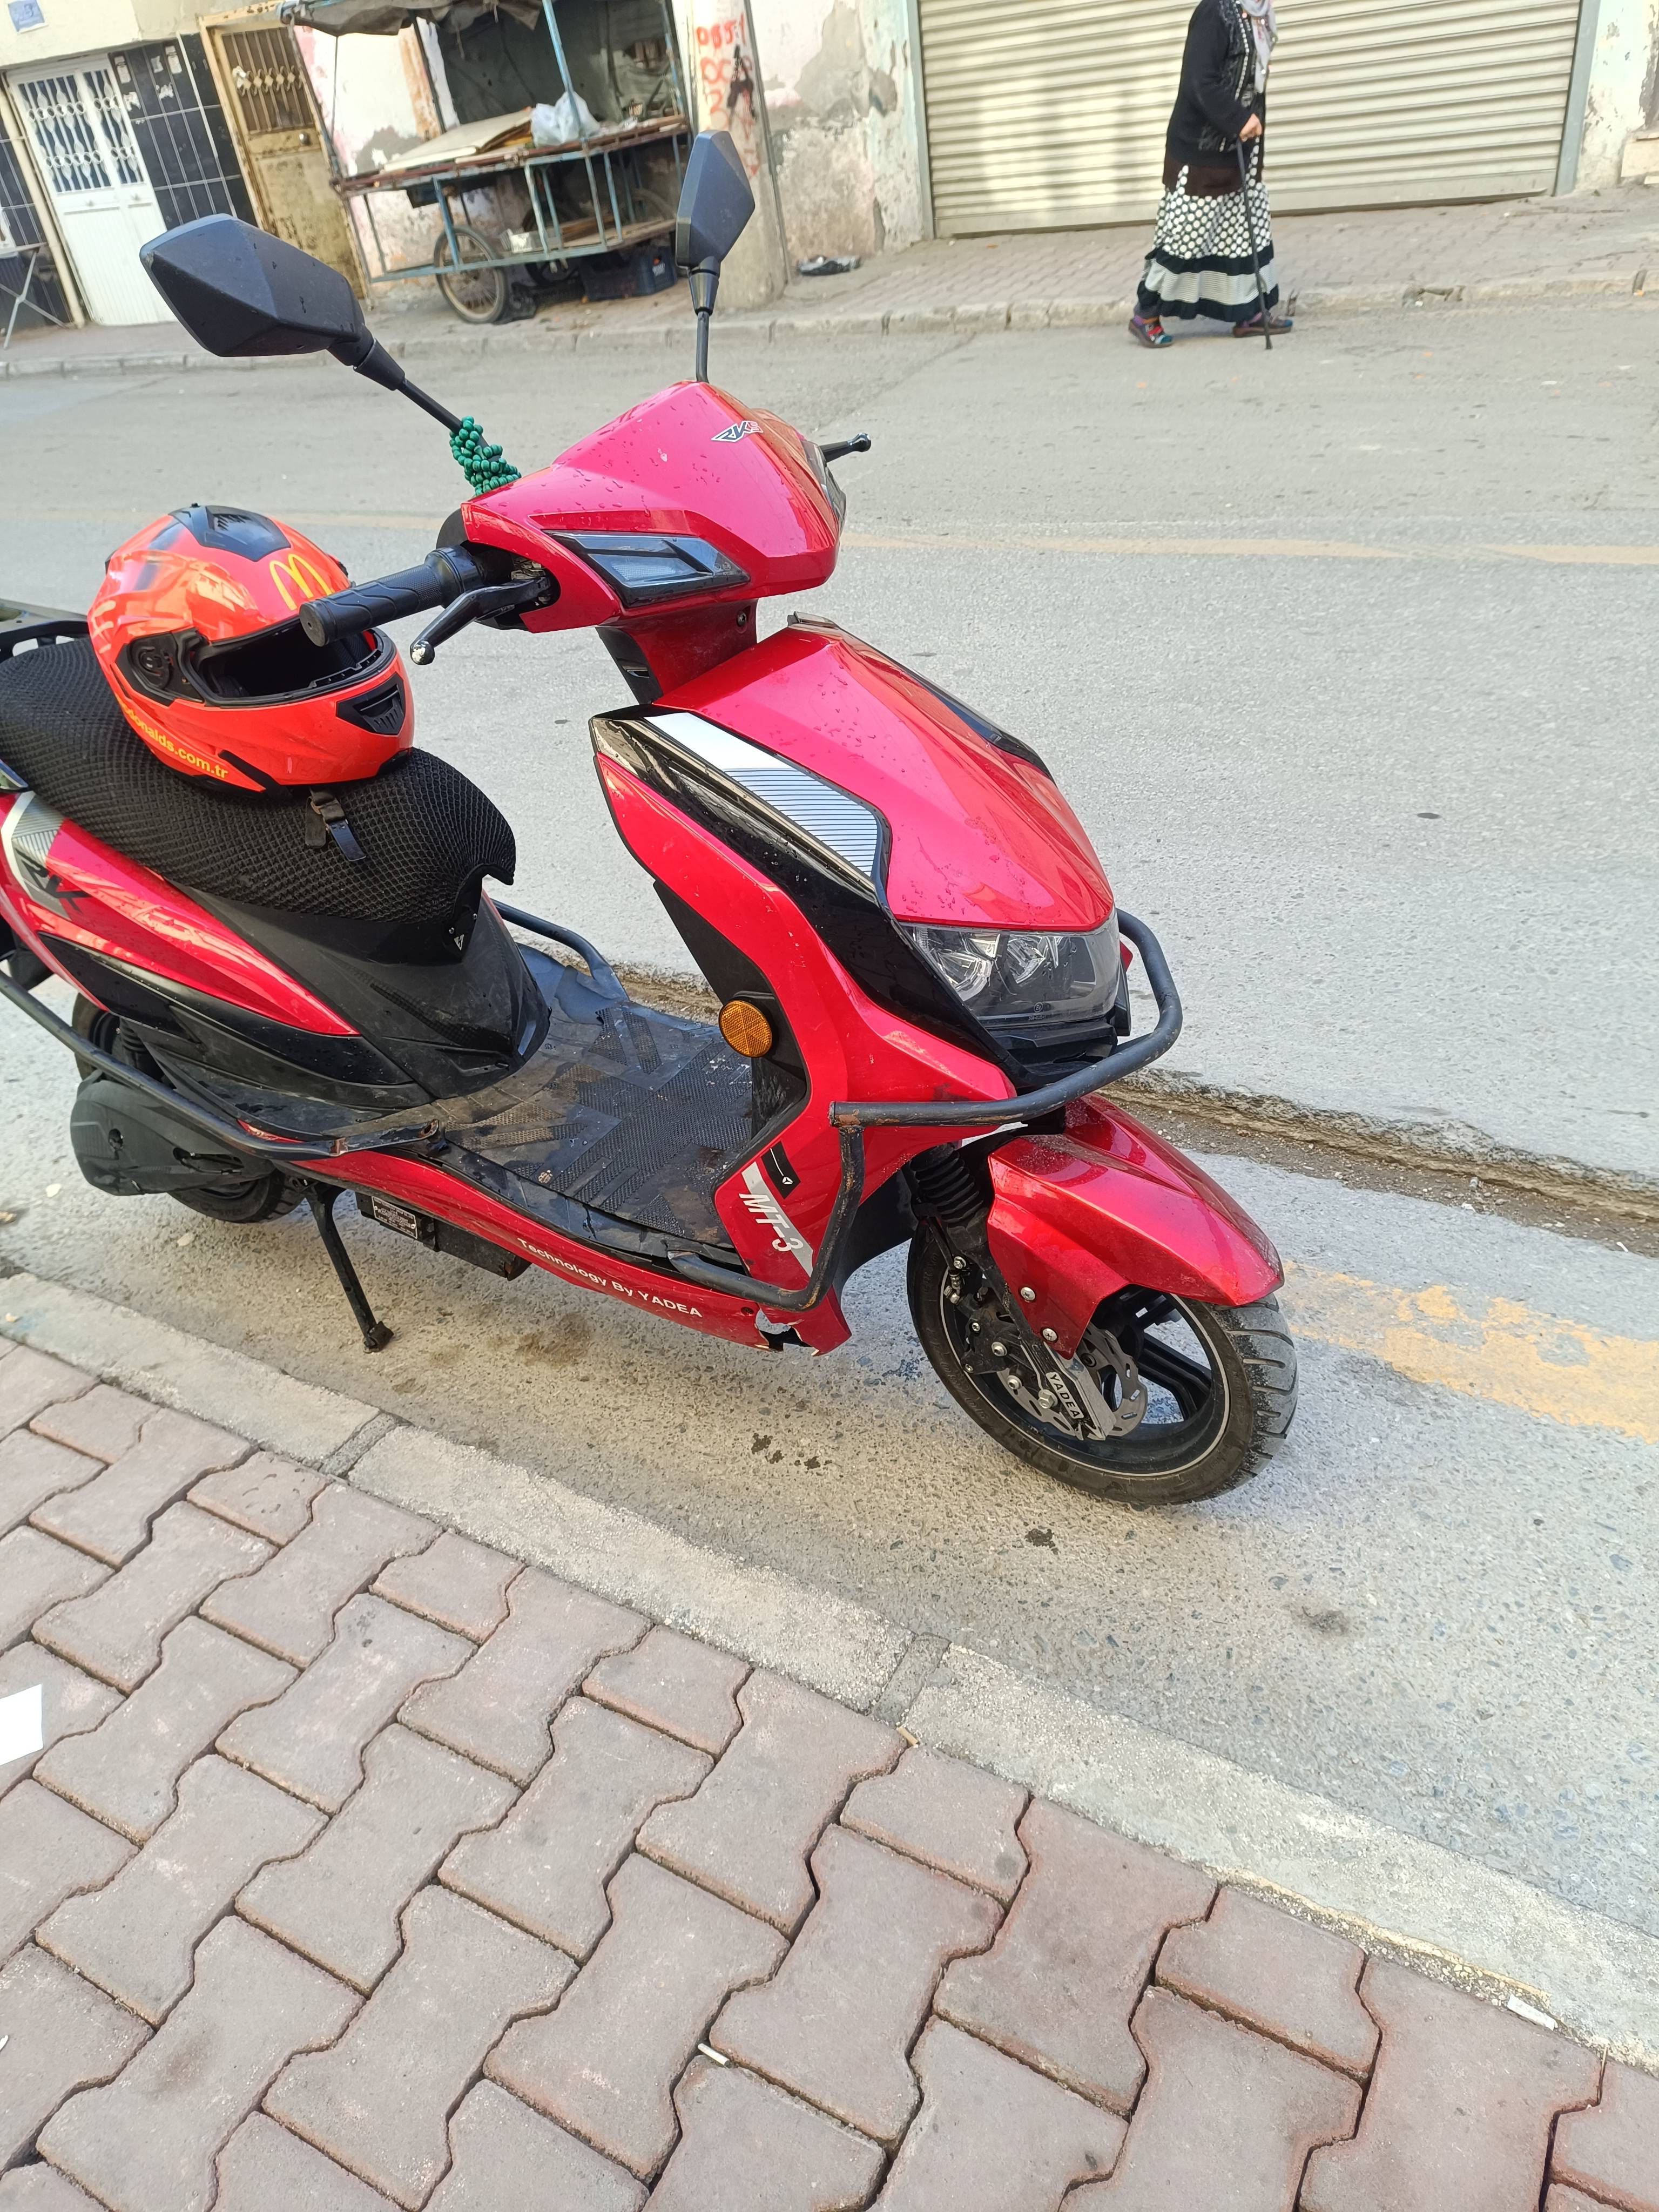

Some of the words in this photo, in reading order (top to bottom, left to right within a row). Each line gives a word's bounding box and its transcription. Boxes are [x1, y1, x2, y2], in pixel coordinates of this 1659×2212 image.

[738, 1193, 804, 1252] MT-3
[517, 1237, 606, 1286] Technology
[611, 1280, 633, 1297] By
[638, 1290, 703, 1318] YADEA
[1050, 1374, 1080, 1417] YADEA
